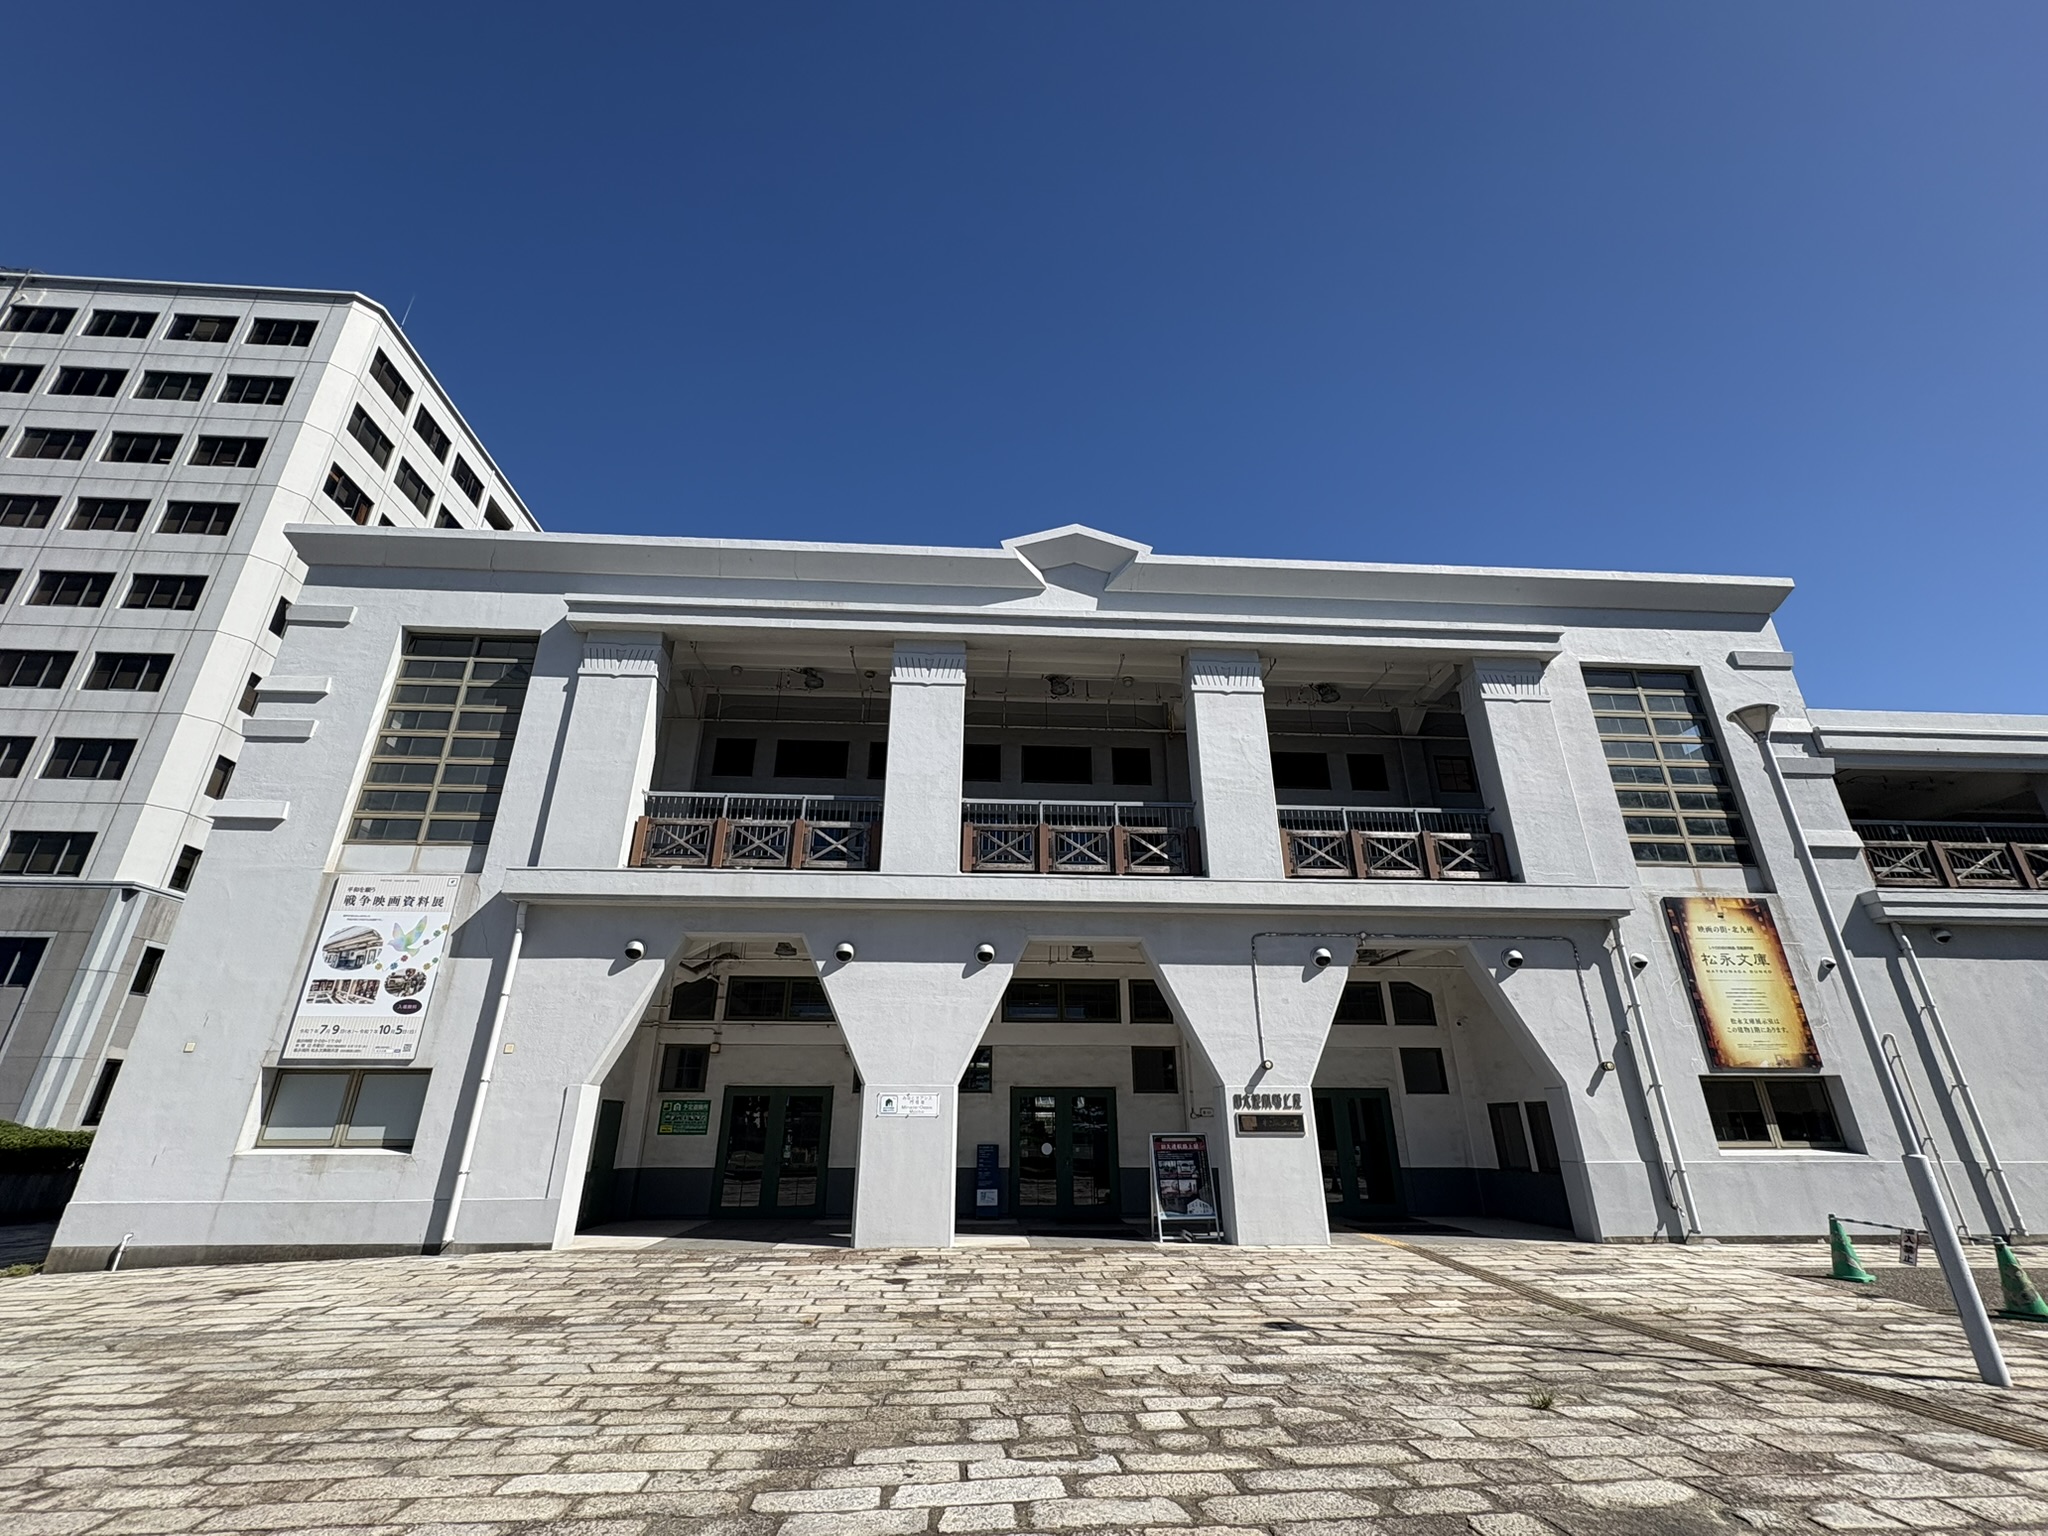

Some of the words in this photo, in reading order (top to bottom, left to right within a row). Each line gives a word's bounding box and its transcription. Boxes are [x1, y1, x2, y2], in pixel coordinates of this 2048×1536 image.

[343, 894, 445, 908] 戦争映画資料展
[1697, 925, 1755, 934] 映画の街・北九州
[1700, 952, 1771, 967] 松永文庫
